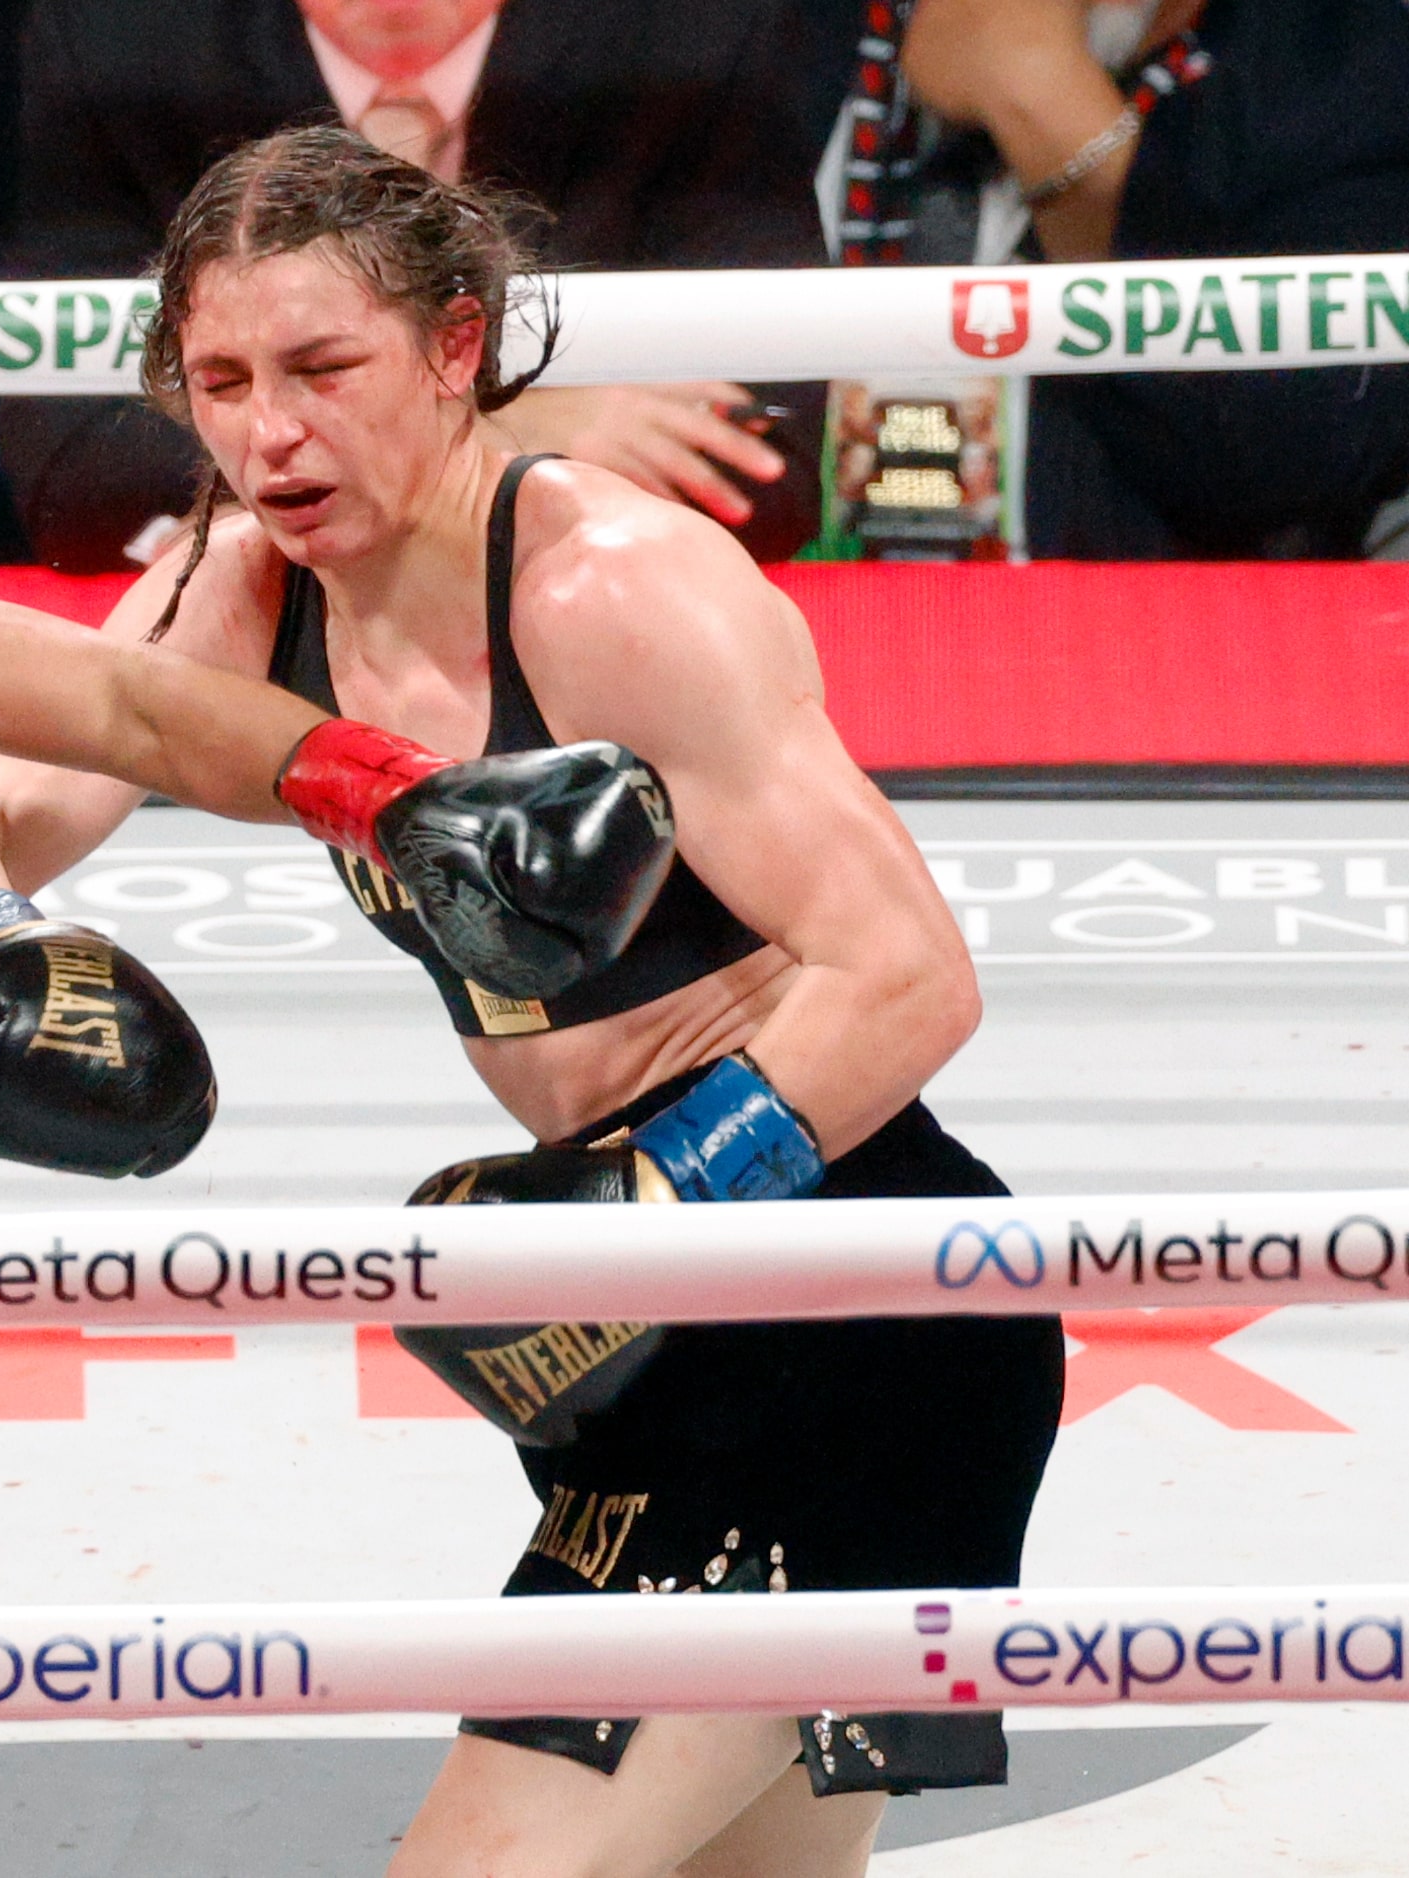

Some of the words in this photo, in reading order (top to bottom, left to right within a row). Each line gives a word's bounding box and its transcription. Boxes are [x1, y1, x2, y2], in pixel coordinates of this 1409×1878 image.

[1057, 271, 1409, 357] SPATEN
[159, 1230, 438, 1309] Quest
[1068, 1217, 1301, 1287] Meta
[461, 1322, 650, 1425] EVERLA
[993, 1599, 1409, 1700] experia
